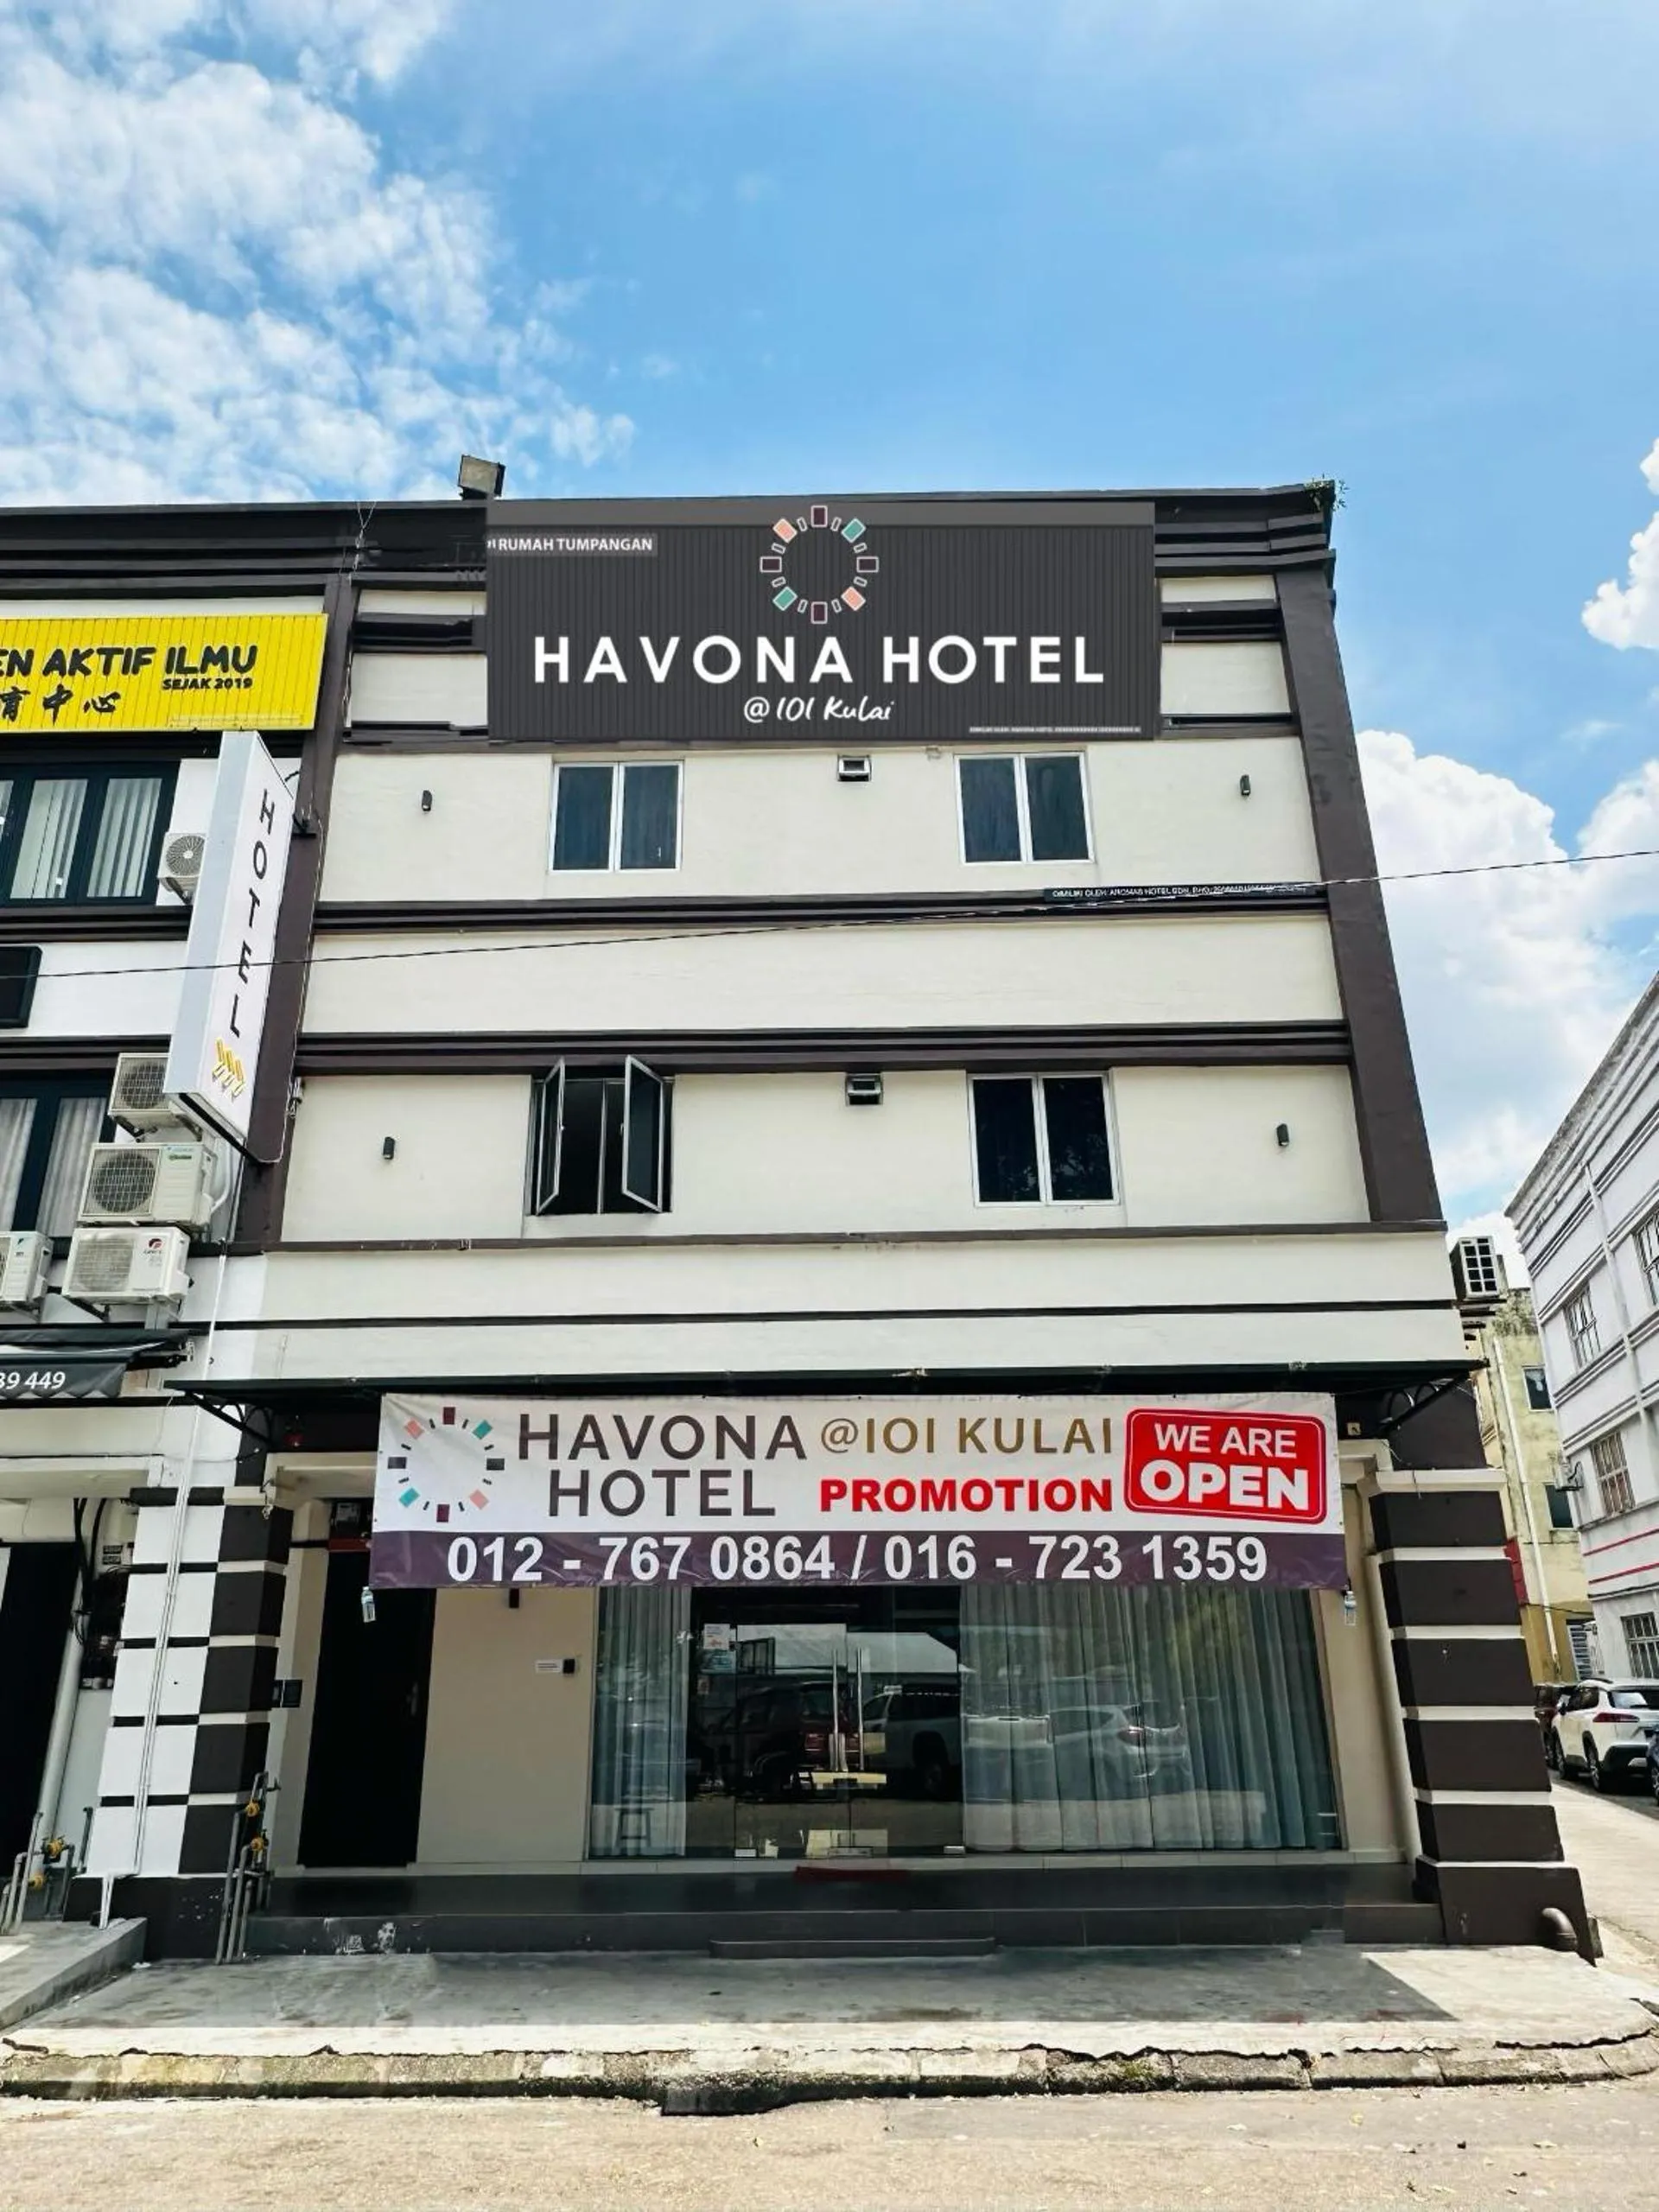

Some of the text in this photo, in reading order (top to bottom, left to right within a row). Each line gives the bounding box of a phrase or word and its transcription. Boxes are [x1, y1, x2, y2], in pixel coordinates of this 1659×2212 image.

[499, 537, 554, 551] RUMAH
[556, 537, 653, 551] TUMPANGAN
[43, 645, 156, 677] AKTIF
[164, 645, 258, 675] ILMU
[534, 635, 1104, 683] HAVONA HOTEL
[162, 677, 253, 690] SEJAK 2019
[823, 695, 895, 722] Kulai
[229, 788, 276, 1039] HOTEL
[24, 1370, 67, 1390] 449
[518, 1414, 807, 1460] HAVONA
[958, 1417, 1113, 1454] KULAI
[1154, 1423, 1298, 1459] WE ARE
[549, 1469, 776, 1517] HOTEL
[819, 1478, 1113, 1513] PROMOTION
[1140, 1459, 1310, 1511] OPEN
[447, 1535, 544, 1582] 012
[598, 1535, 692, 1582] 767
[709, 1535, 836, 1582] 0864
[883, 1535, 977, 1580] 016
[1028, 1535, 1123, 1580] 723
[1141, 1535, 1268, 1582] 1359
